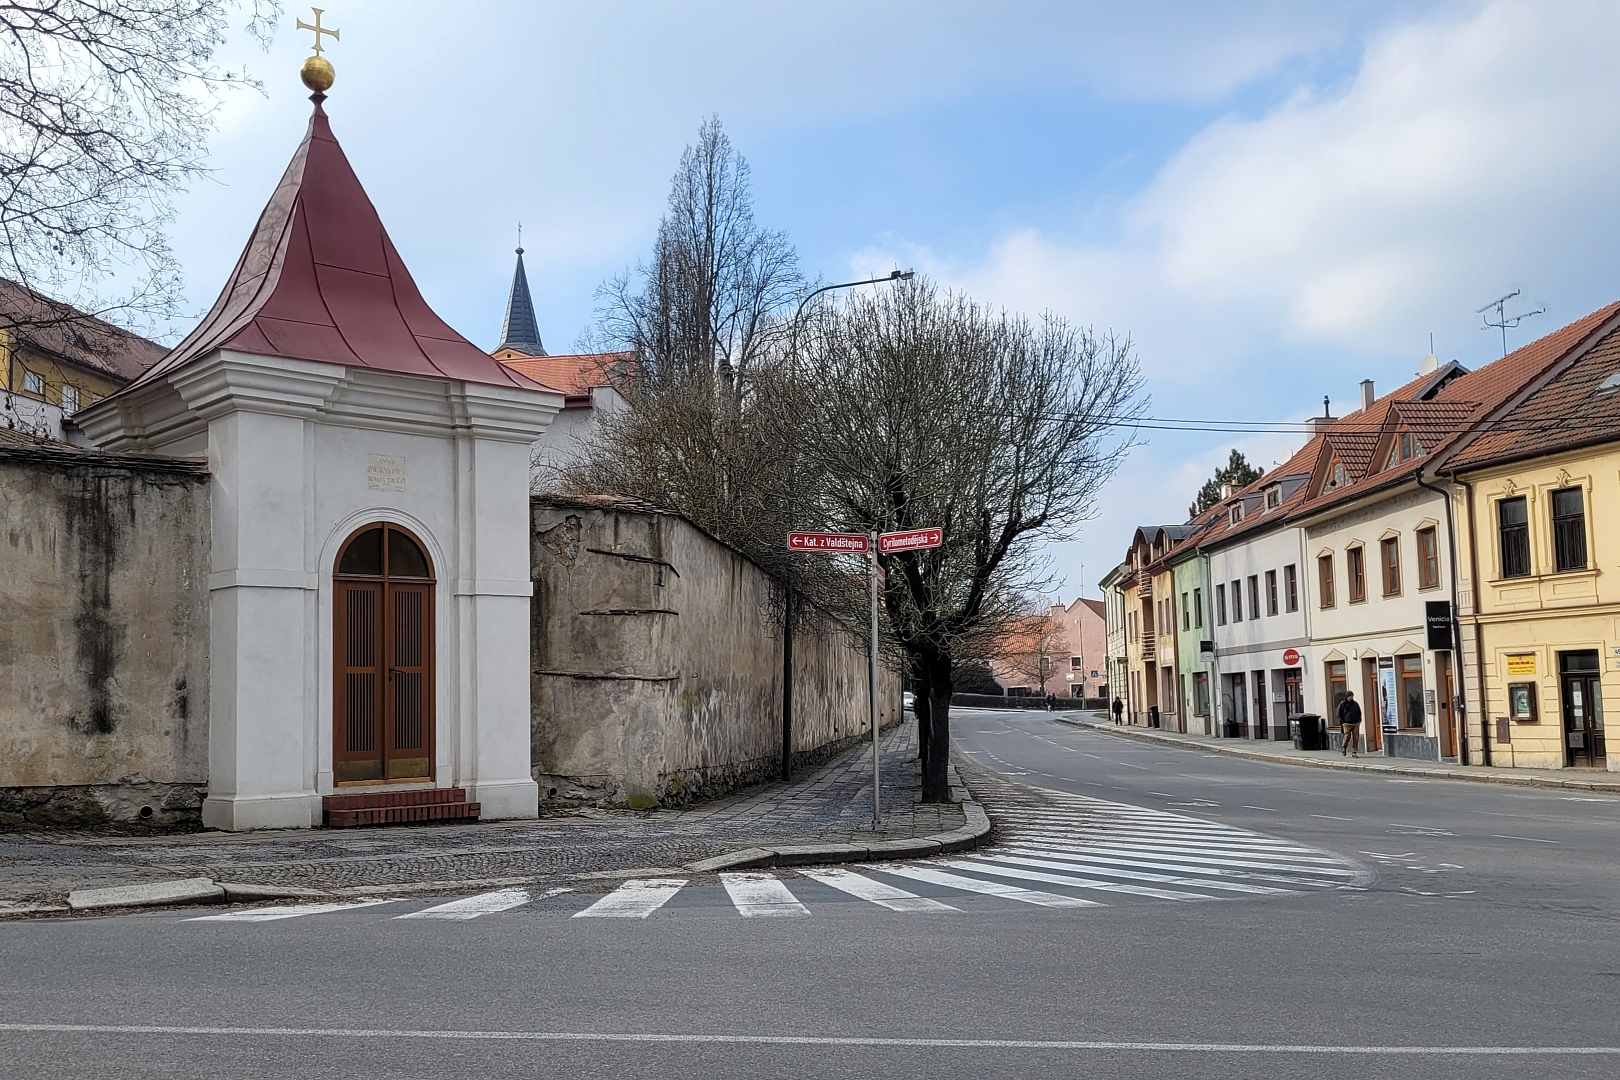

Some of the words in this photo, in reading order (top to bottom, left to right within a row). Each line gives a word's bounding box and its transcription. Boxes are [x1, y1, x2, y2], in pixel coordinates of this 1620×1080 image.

[804, 537, 819, 547] Kat.
[826, 538, 863, 550] Valdštejna
[883, 533, 928, 550] Cyrilometodějská
